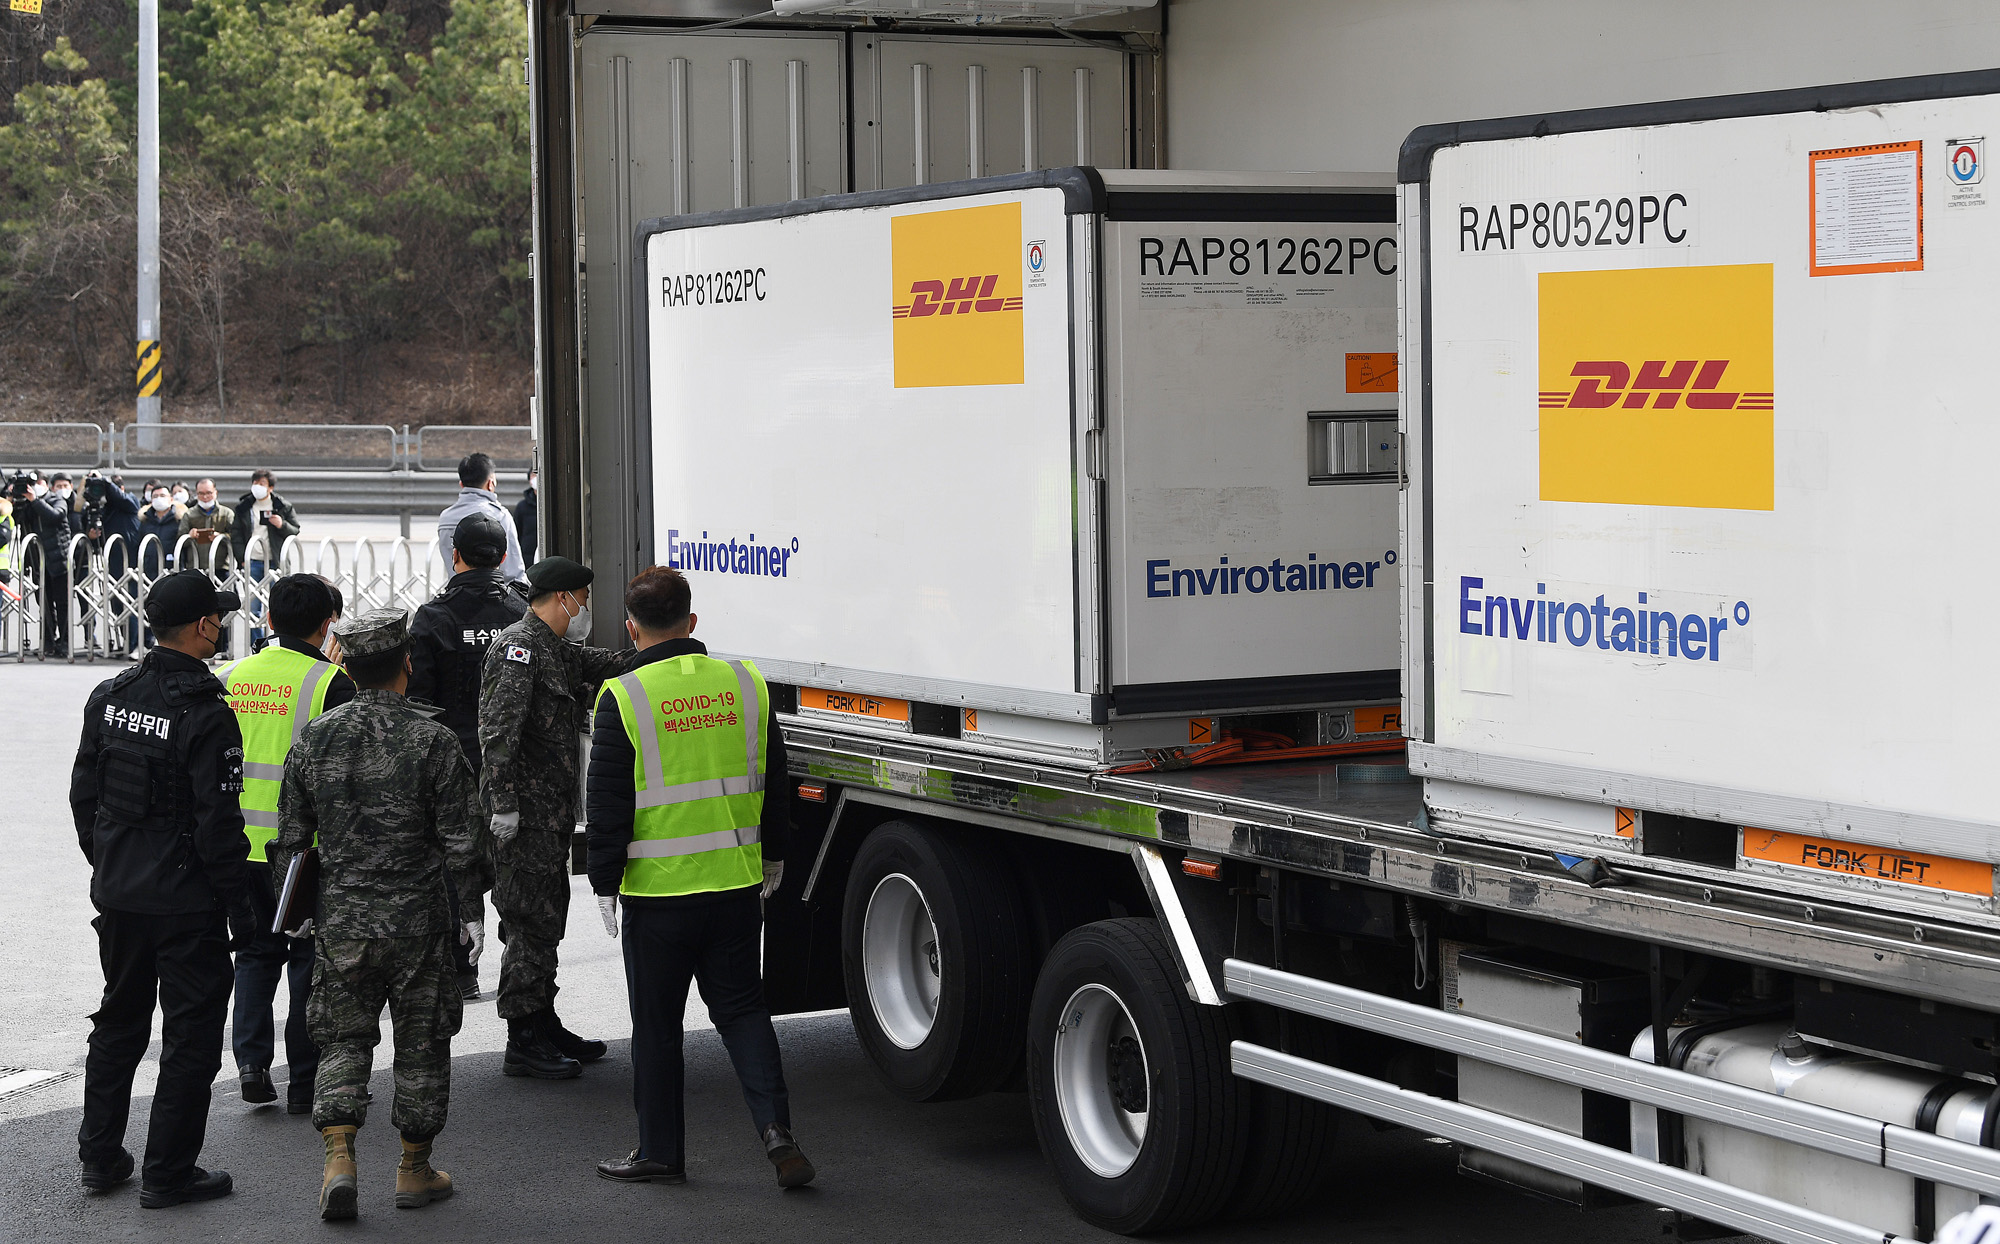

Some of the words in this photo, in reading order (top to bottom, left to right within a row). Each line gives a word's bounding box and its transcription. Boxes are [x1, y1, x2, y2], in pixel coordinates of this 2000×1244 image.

[1460, 193, 1687, 251] RAP80529PC
[1139, 237, 1397, 277] RAP81262PC
[661, 267, 767, 308] RAP81262PC
[909, 274, 1005, 317] DHL
[1567, 360, 1741, 409] DHL
[230, 700, 289, 716] 백신안전수송
[232, 682, 293, 699] COVID-19
[661, 691, 735, 715] COVID-19
[826, 694, 855, 712] FORK
[859, 697, 882, 716] LIFT
[104, 704, 170, 740] 특수임무대
[664, 710, 738, 734] 백신안전수송
[1803, 844, 1867, 873] FORK
[1878, 855, 1930, 882] LIFT
